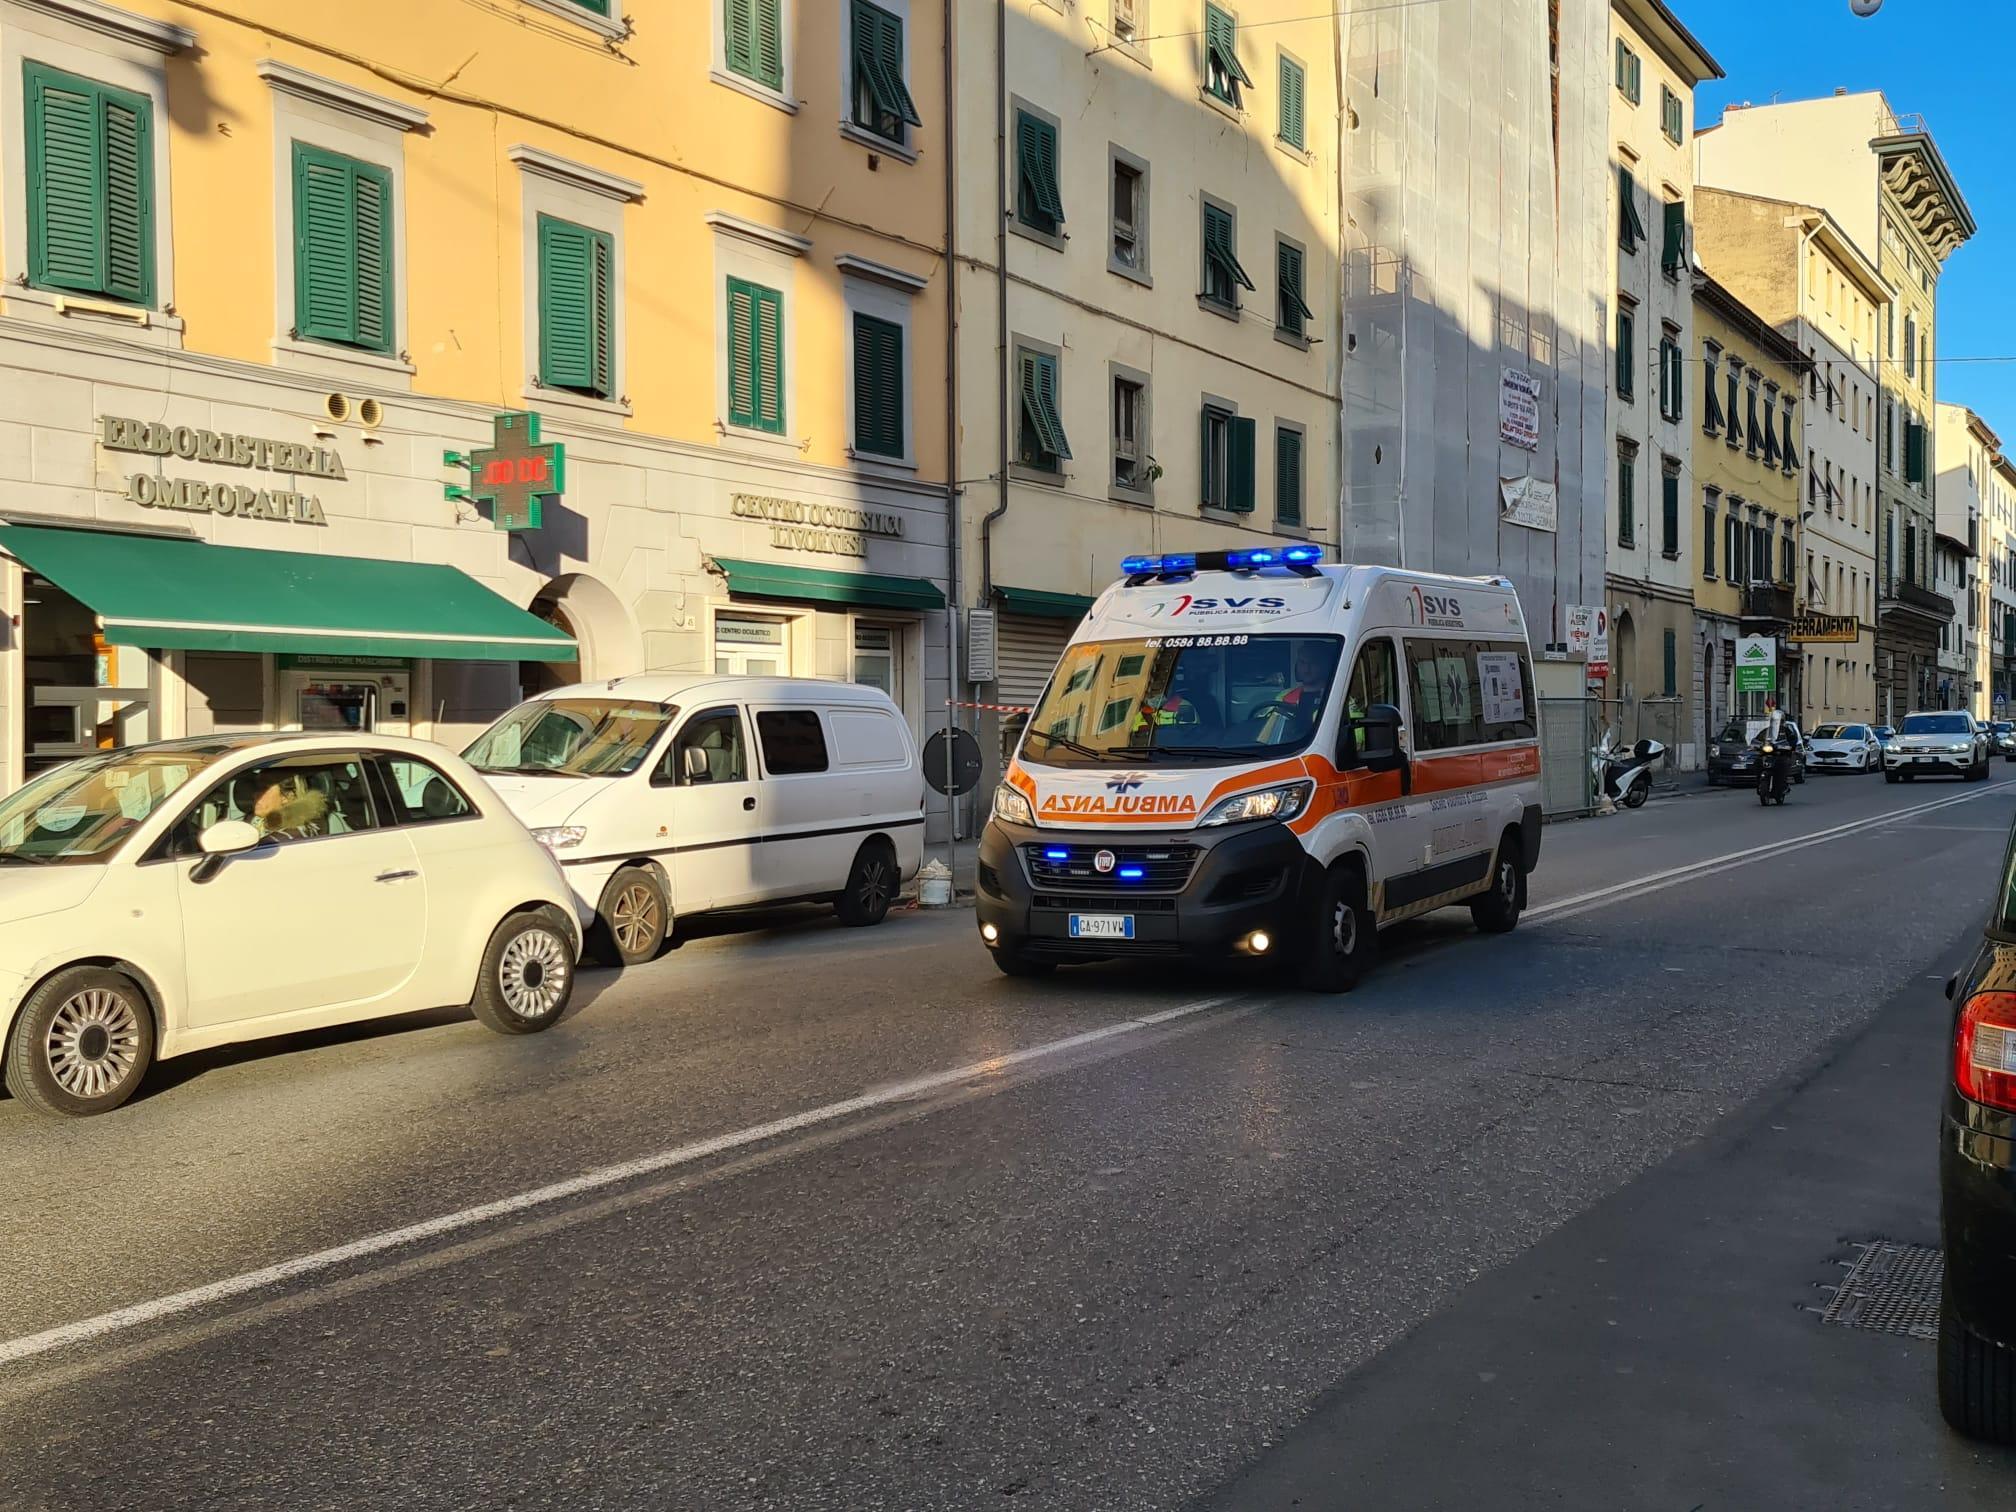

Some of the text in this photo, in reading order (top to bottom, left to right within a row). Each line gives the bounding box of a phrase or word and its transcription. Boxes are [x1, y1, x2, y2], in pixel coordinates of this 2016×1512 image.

[101, 414, 348, 480] ERBORISTERIA
[127, 473, 328, 526] OMEOPATIA
[730, 493, 905, 538] CENTRO OCULISTICO
[770, 526, 869, 557] LIVORNESE
[1191, 598, 1286, 609] SVS
[1423, 595, 1462, 616] SVS
[1791, 617, 1855, 636] FERRAMENTA
[1145, 635, 1249, 648] tel. 0586 88.88.88
